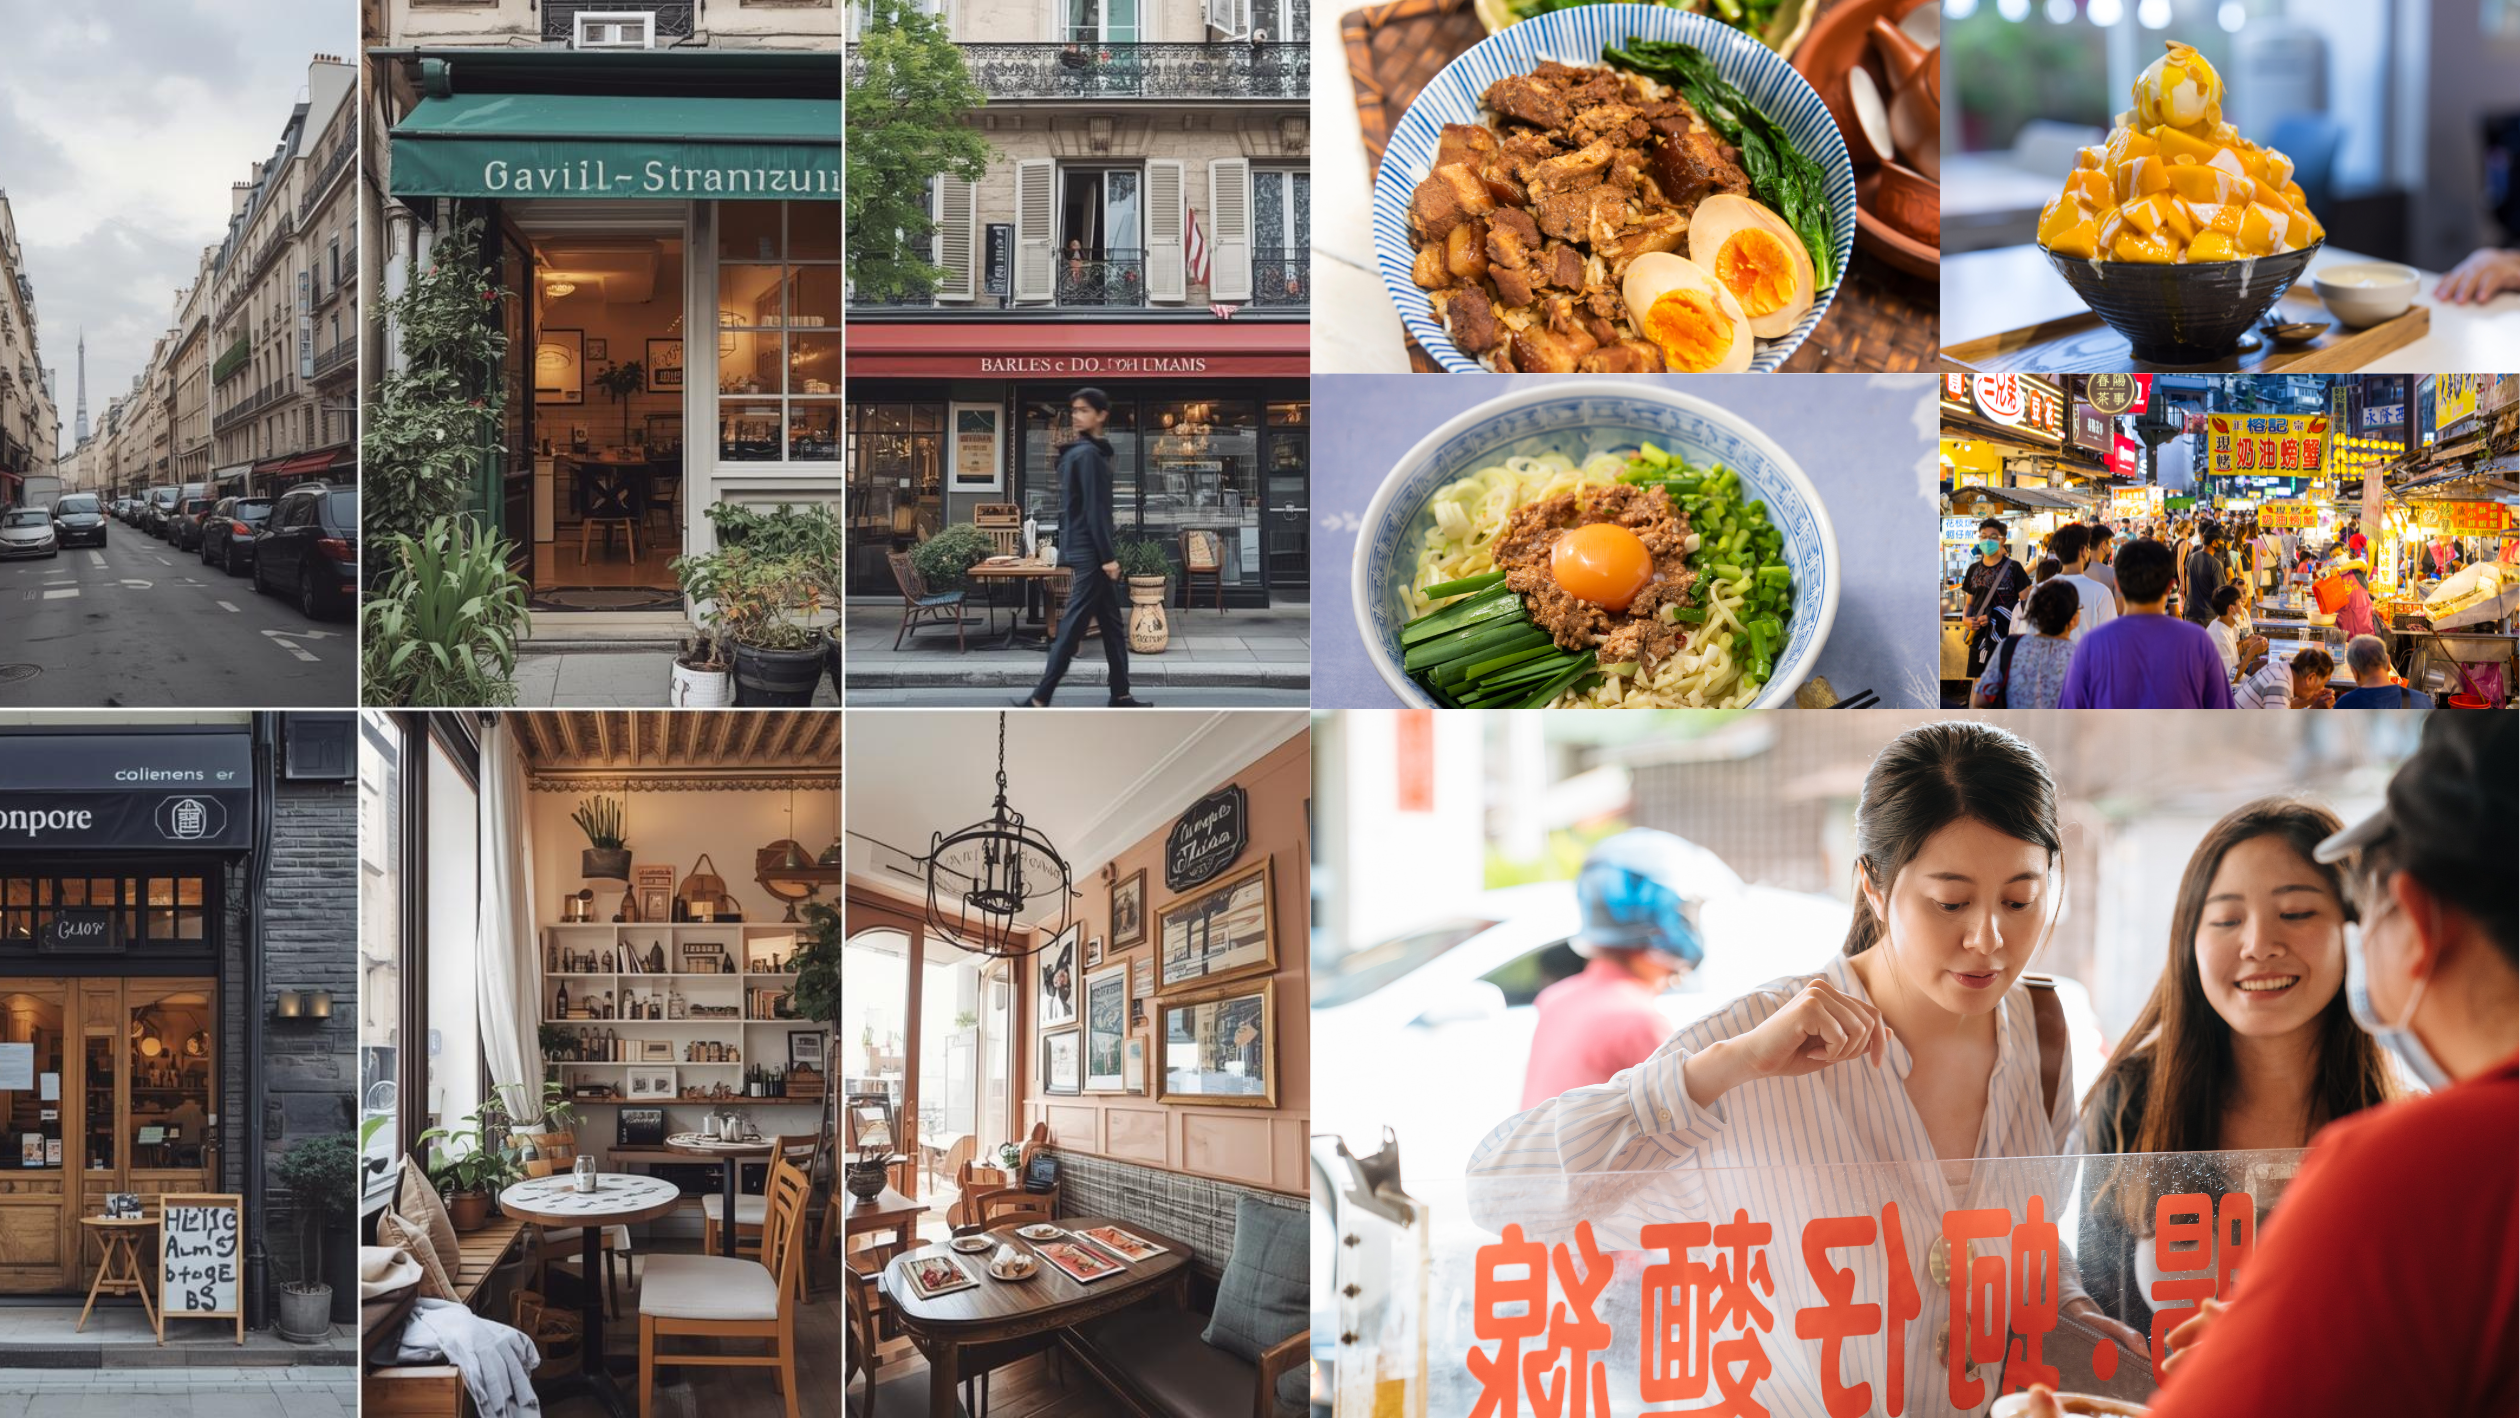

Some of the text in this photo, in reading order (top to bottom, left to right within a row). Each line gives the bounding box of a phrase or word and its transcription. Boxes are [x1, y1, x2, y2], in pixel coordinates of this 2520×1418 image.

[2096, 391, 2126, 406] 茶事
[2031, 397, 2055, 426] 豆花
[2246, 417, 2289, 433] 榕記
[2236, 437, 2321, 469] 奶油螃蟹
[2262, 515, 2315, 526] 奶油螃蟹
